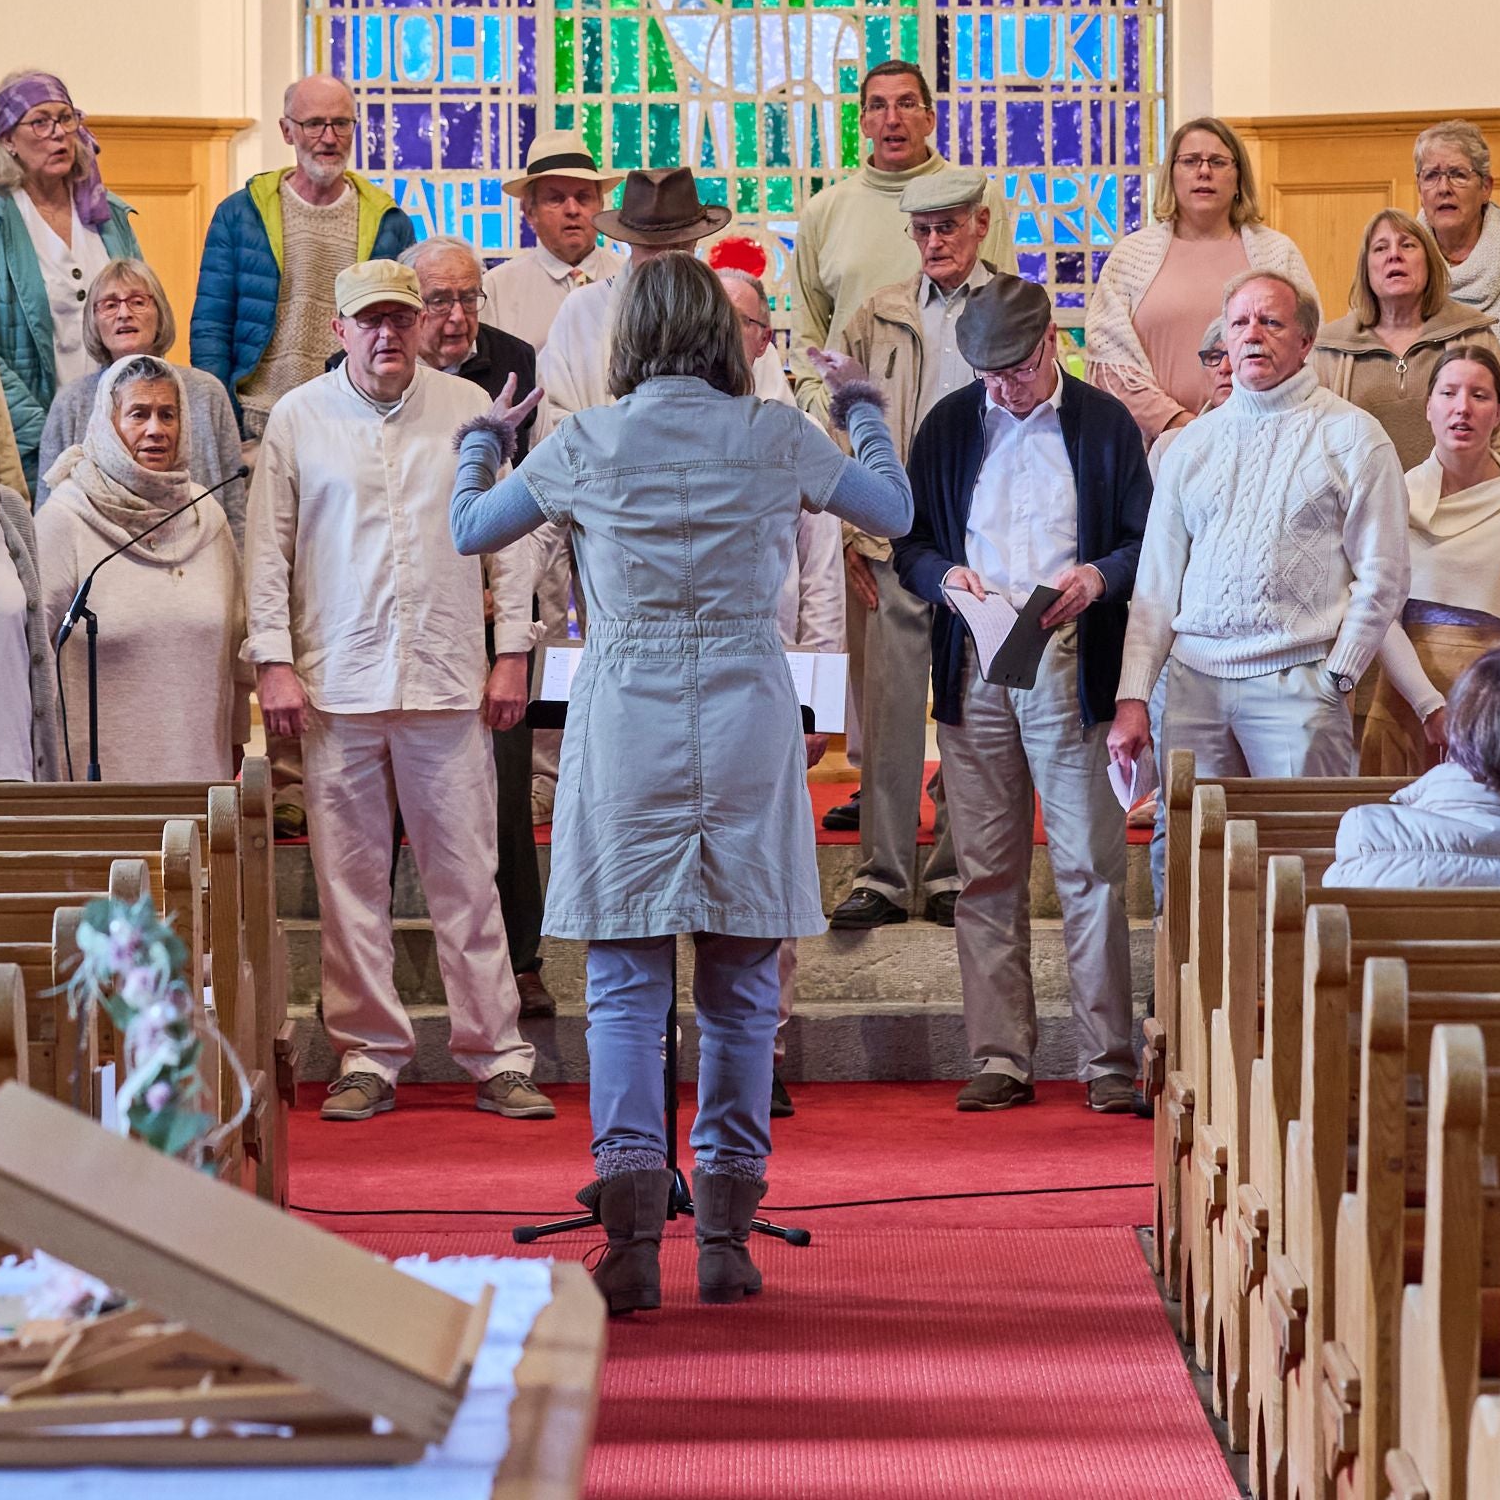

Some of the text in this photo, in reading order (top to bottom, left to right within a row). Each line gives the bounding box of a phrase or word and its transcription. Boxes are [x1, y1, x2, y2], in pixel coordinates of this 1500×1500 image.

[360, 13, 484, 84] JOH
[992, 12, 1104, 84] LUK
[990, 168, 1118, 246] ARK
